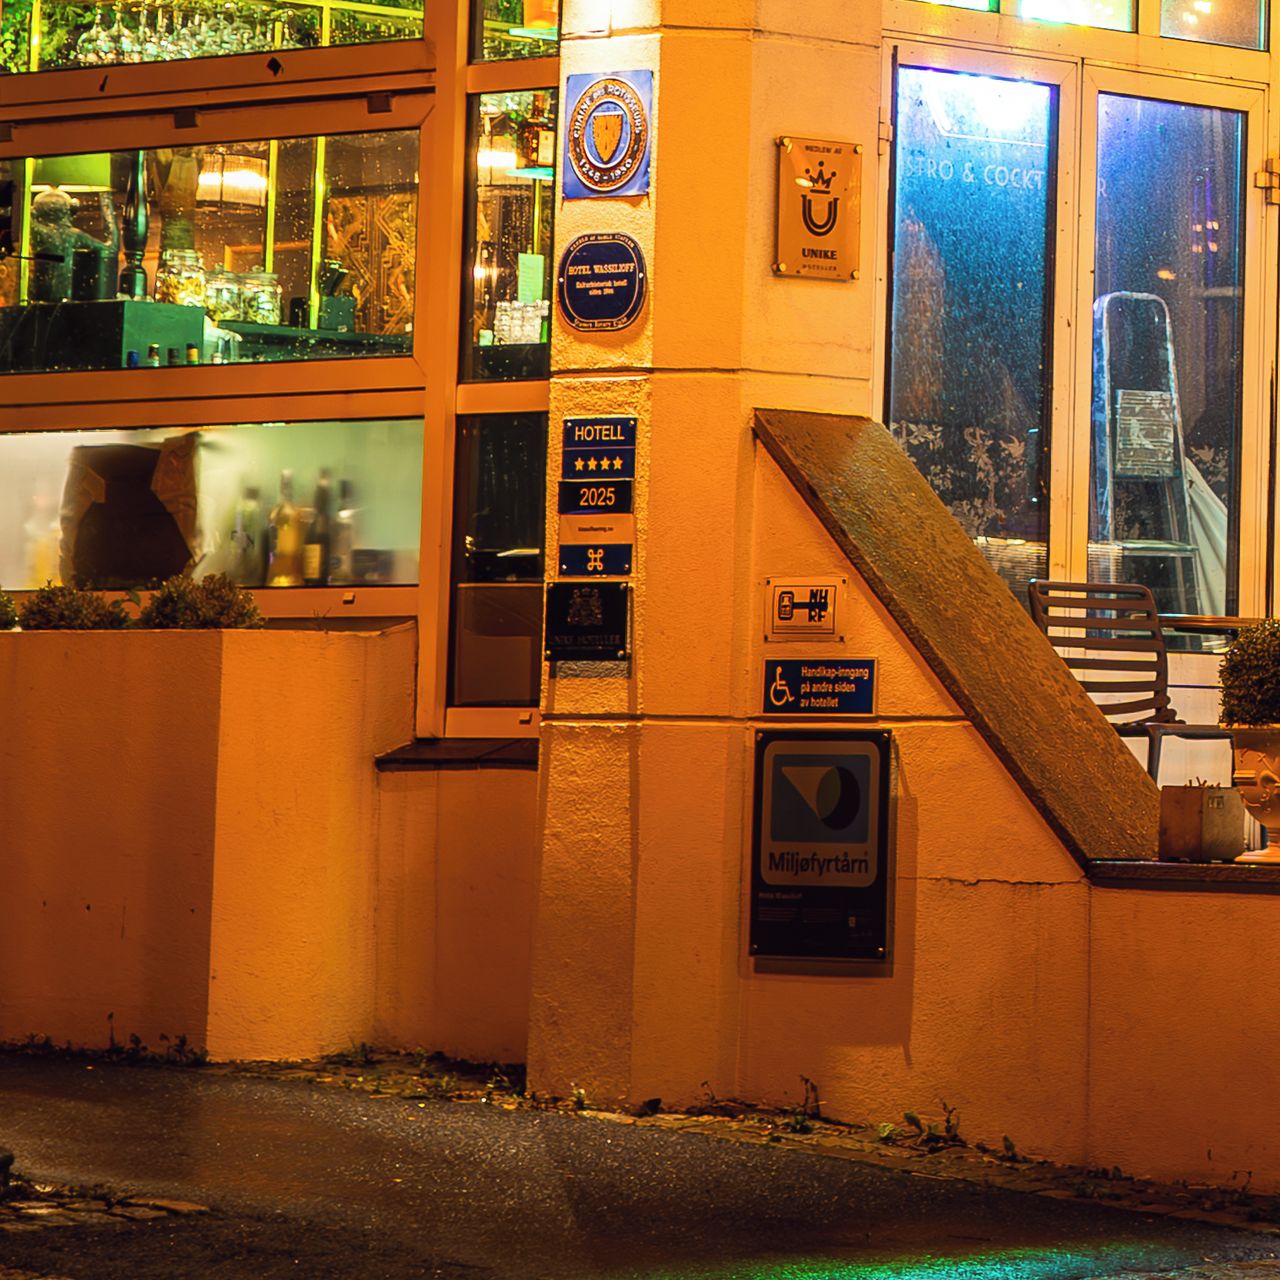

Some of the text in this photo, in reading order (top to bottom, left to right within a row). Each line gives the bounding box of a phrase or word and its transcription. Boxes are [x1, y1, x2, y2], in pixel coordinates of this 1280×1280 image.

[802, 248, 838, 261] UNIKE
[568, 265, 592, 276] HOTEL
[574, 425, 625, 441] HOTELL
[579, 487, 616, 506] 2025
[801, 667, 869, 680] Handikap-inngang
[801, 681, 856, 695] på andre siden
[767, 852, 869, 877] Miljøfyrtårn
